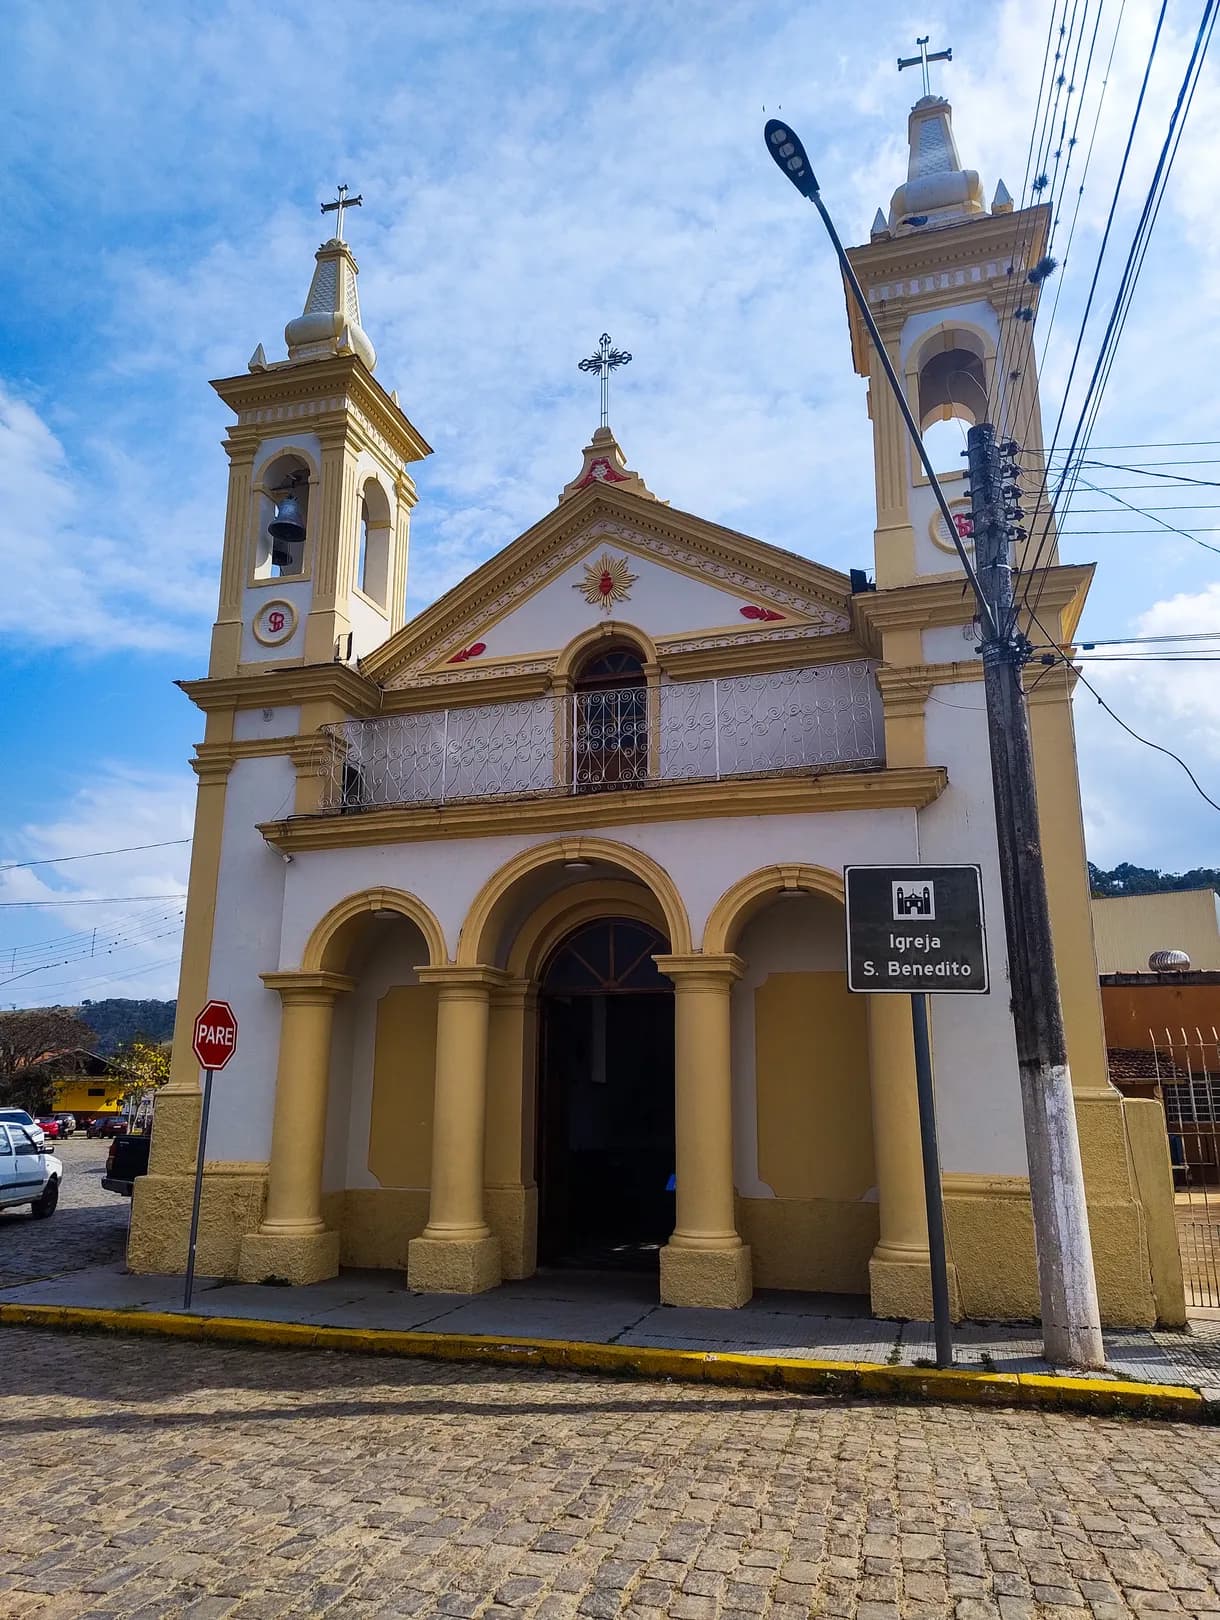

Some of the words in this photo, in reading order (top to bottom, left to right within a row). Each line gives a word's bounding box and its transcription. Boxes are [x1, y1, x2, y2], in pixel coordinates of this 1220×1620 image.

[889, 933, 941, 953] Igreja
[863, 961, 879, 976] S.
[888, 961, 972, 976] Benedito
[198, 1024, 234, 1046] PARE
